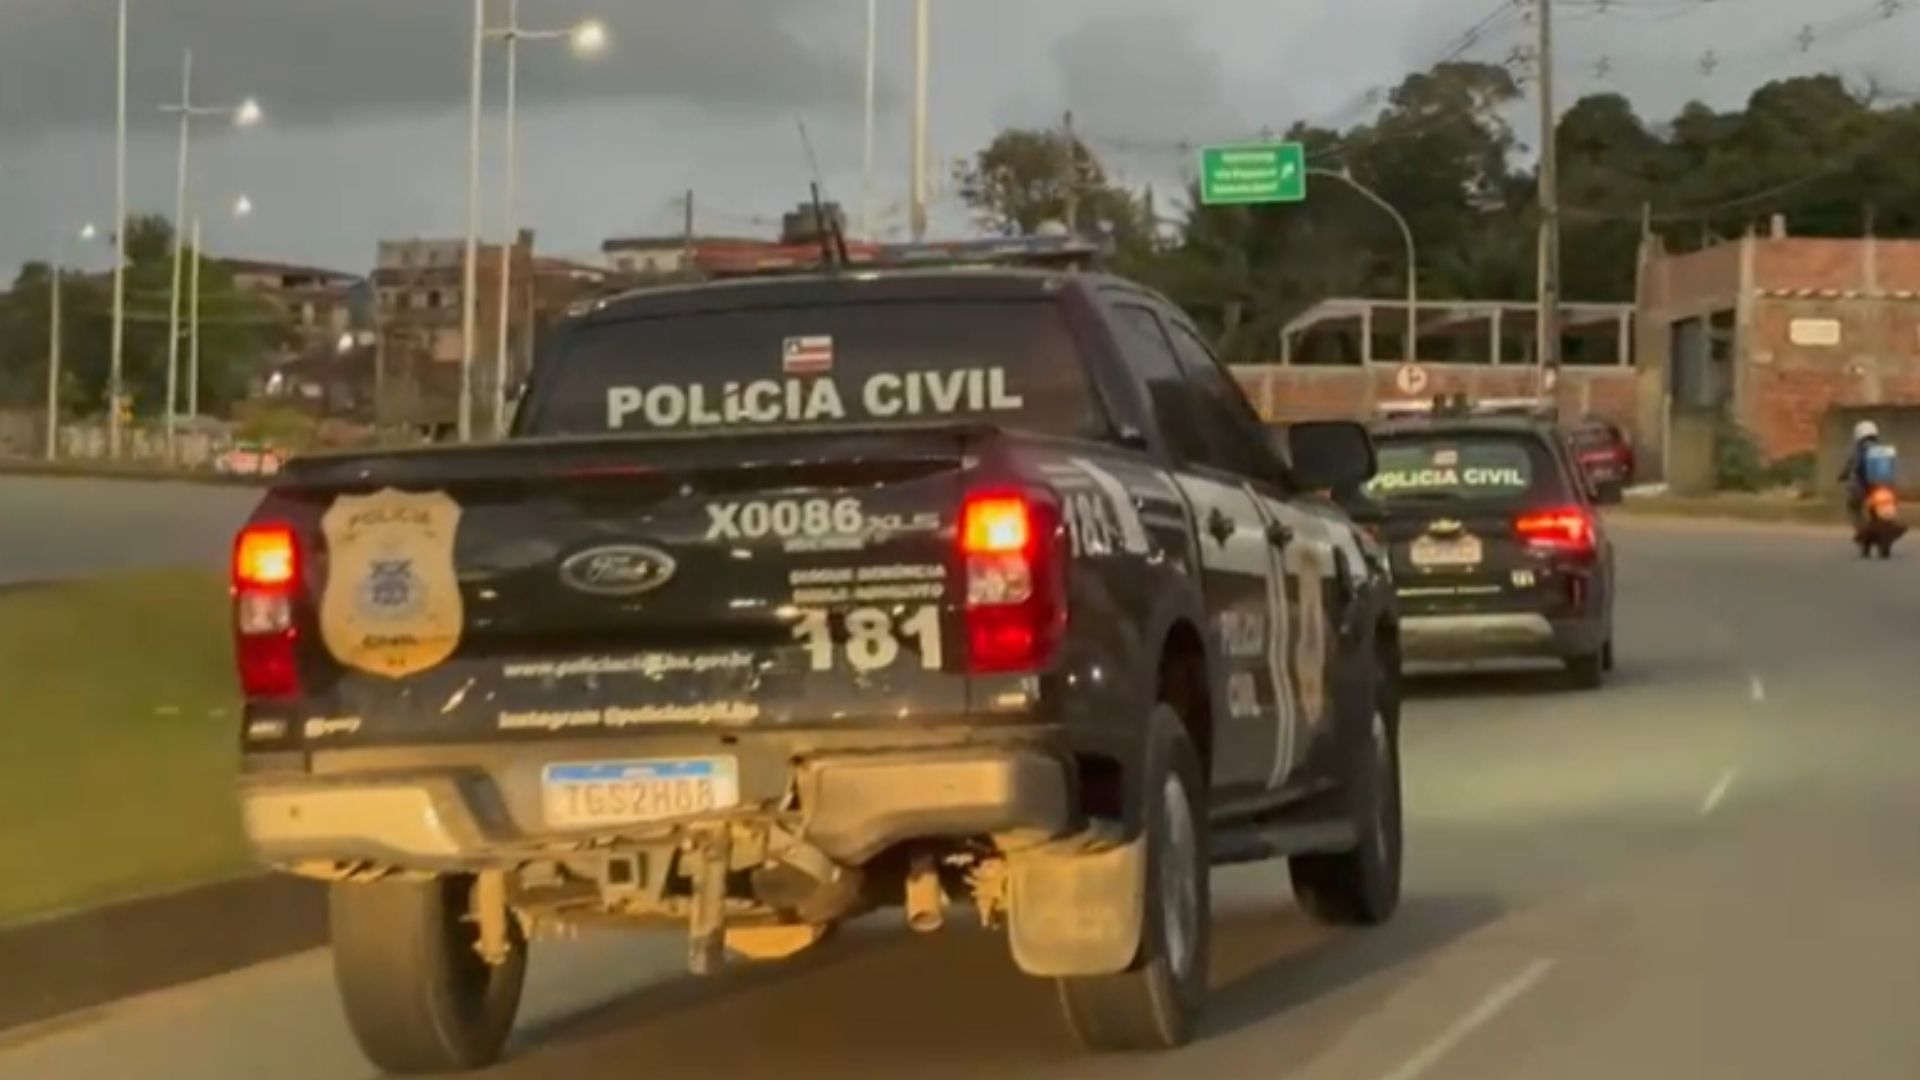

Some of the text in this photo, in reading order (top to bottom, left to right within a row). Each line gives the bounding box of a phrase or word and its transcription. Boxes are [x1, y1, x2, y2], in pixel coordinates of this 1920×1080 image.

[863, 367, 1024, 416] CIVIL
[1463, 467, 1525, 486] CIVIL
[705, 497, 863, 541] X0086
[791, 604, 943, 671] 181
